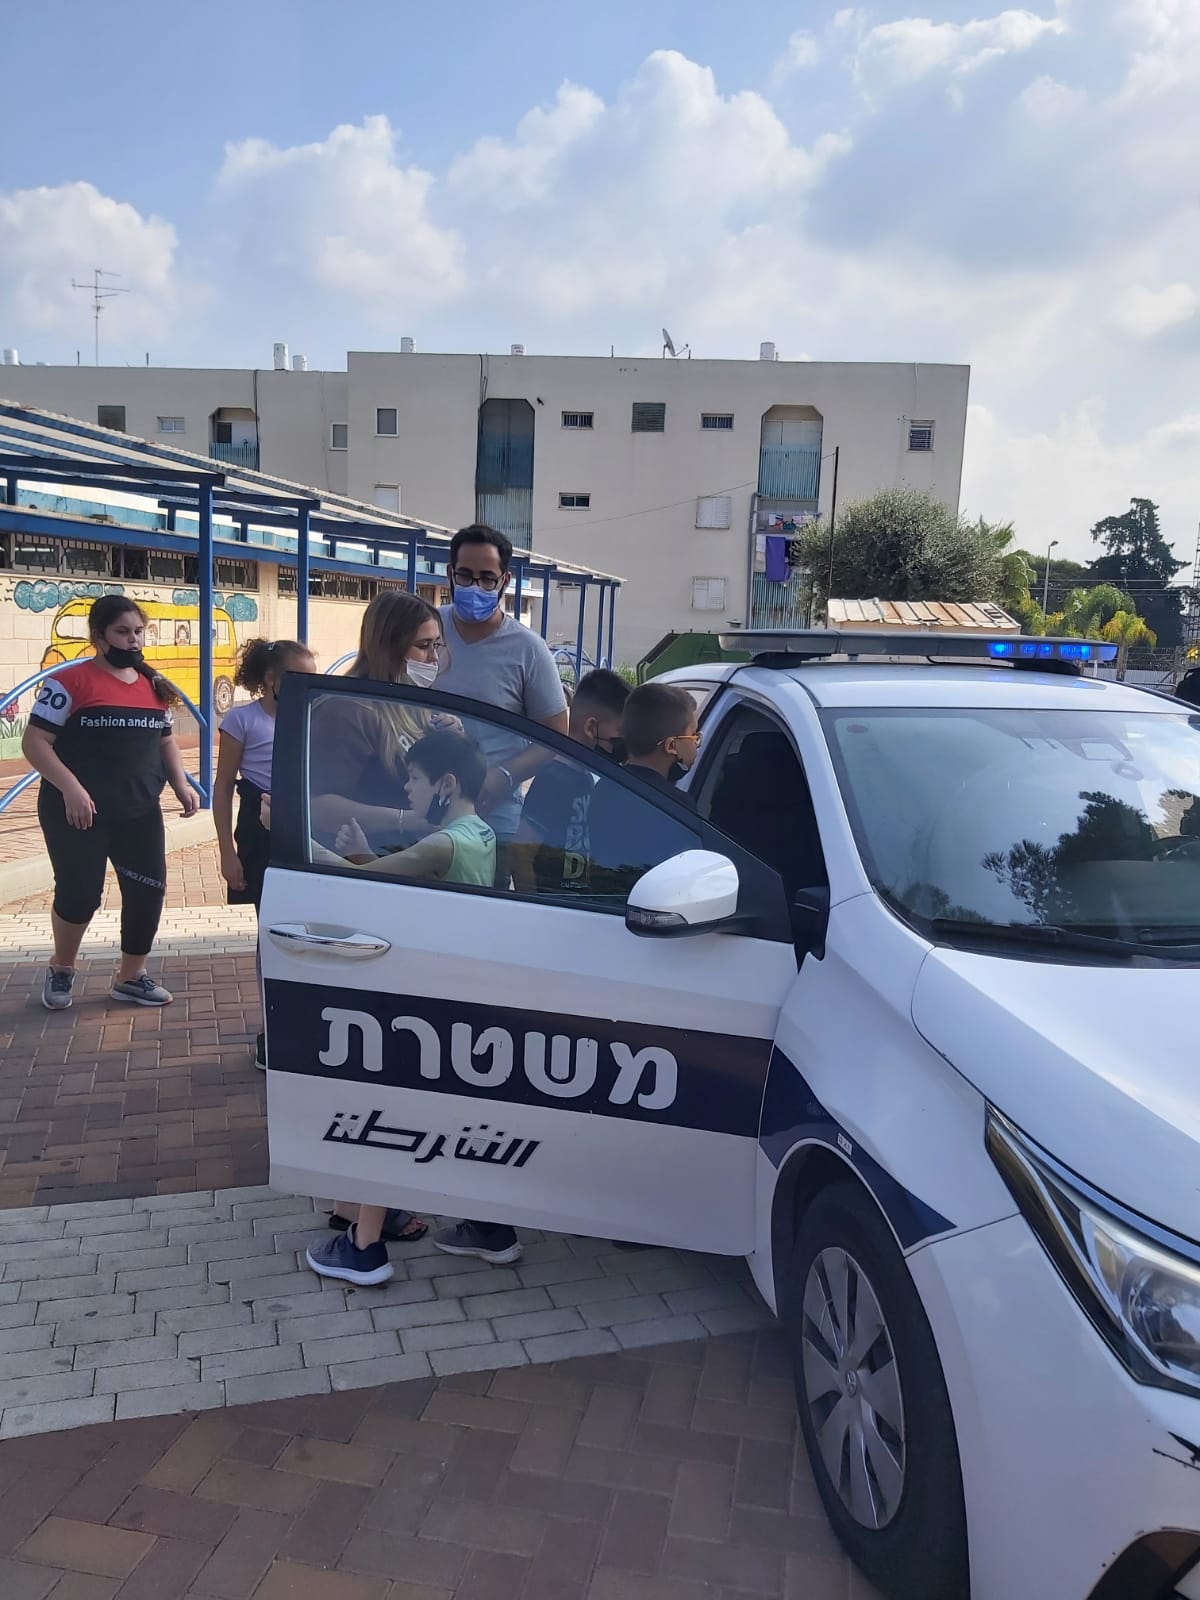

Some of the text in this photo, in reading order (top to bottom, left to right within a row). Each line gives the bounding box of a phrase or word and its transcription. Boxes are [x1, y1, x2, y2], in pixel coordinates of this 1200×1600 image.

[39, 688, 67, 710] 20
[81, 716, 126, 728] Fashion
[128, 717, 148, 728] and
[319, 1006, 678, 1110] משטרת
[323, 1110, 540, 1167] الشرطة
